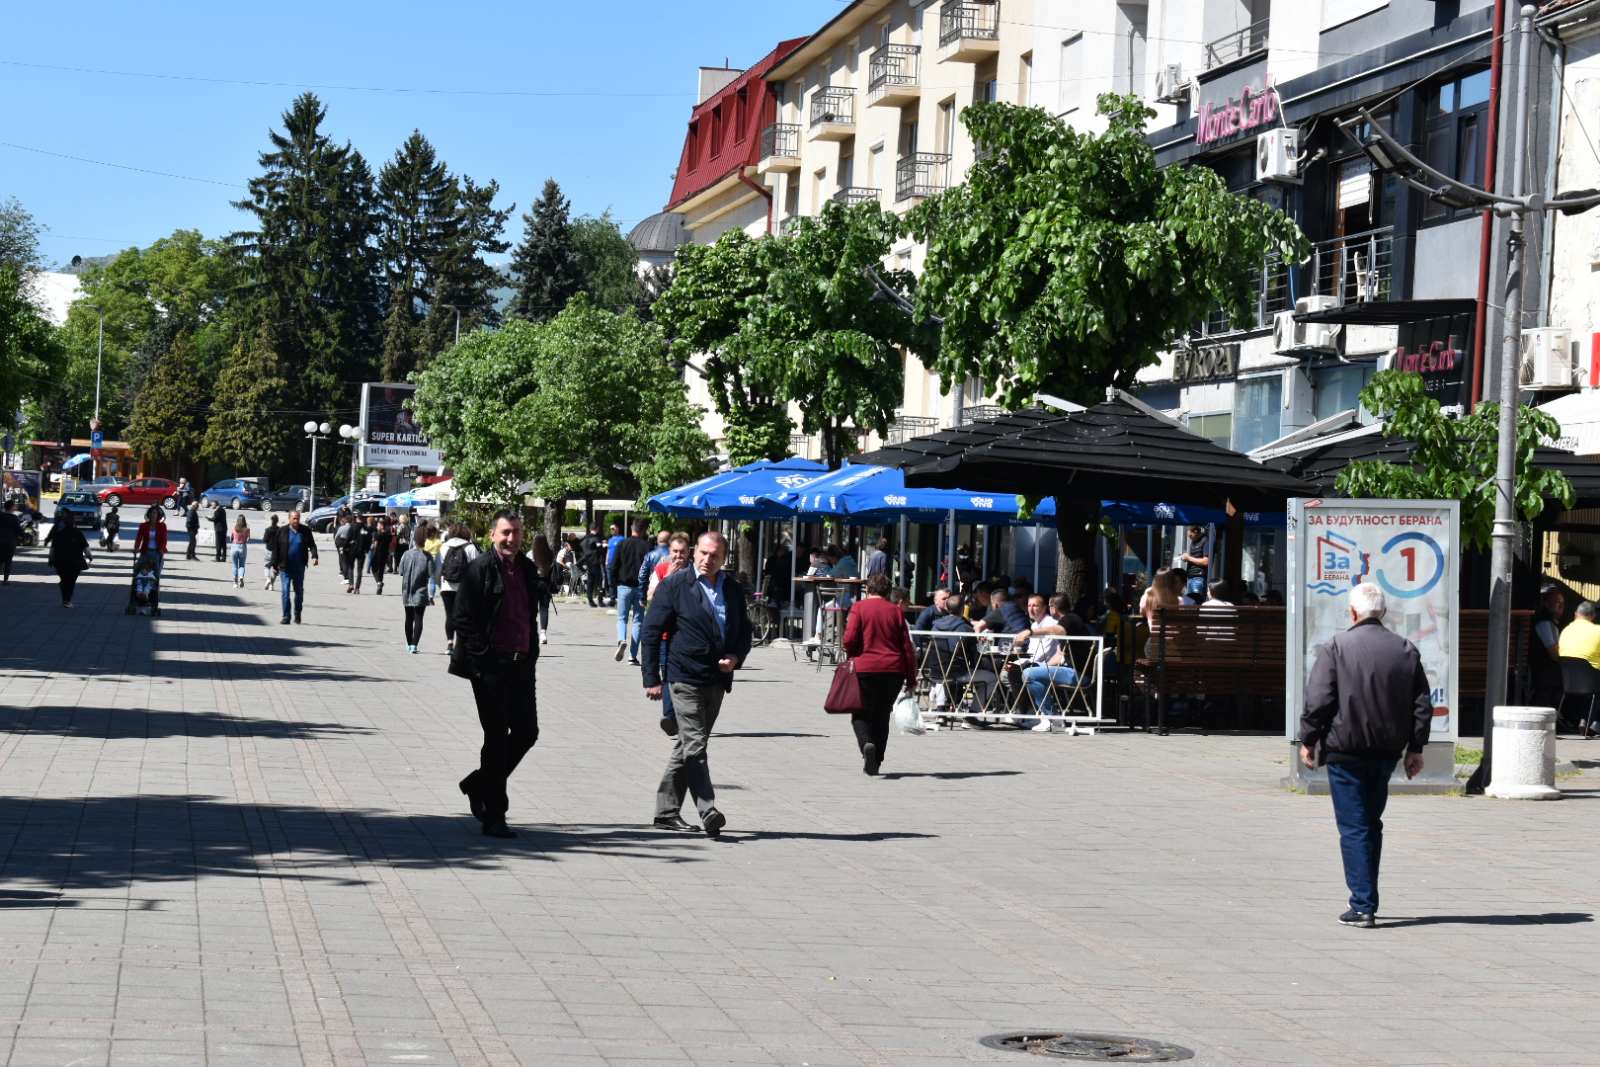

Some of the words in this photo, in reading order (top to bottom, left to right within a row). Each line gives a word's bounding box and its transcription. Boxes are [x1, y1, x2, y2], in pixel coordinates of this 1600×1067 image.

[1196, 99, 1240, 145] Monte
[1240, 72, 1278, 129] Carlo
[371, 431, 395, 442] SUPER
[396, 432, 428, 444] KARTICA
[1308, 515, 1323, 526] ЗА
[1399, 515, 1442, 526] БЕРАНА
[1324, 552, 1350, 570] За
[1400, 547, 1415, 582] 1
